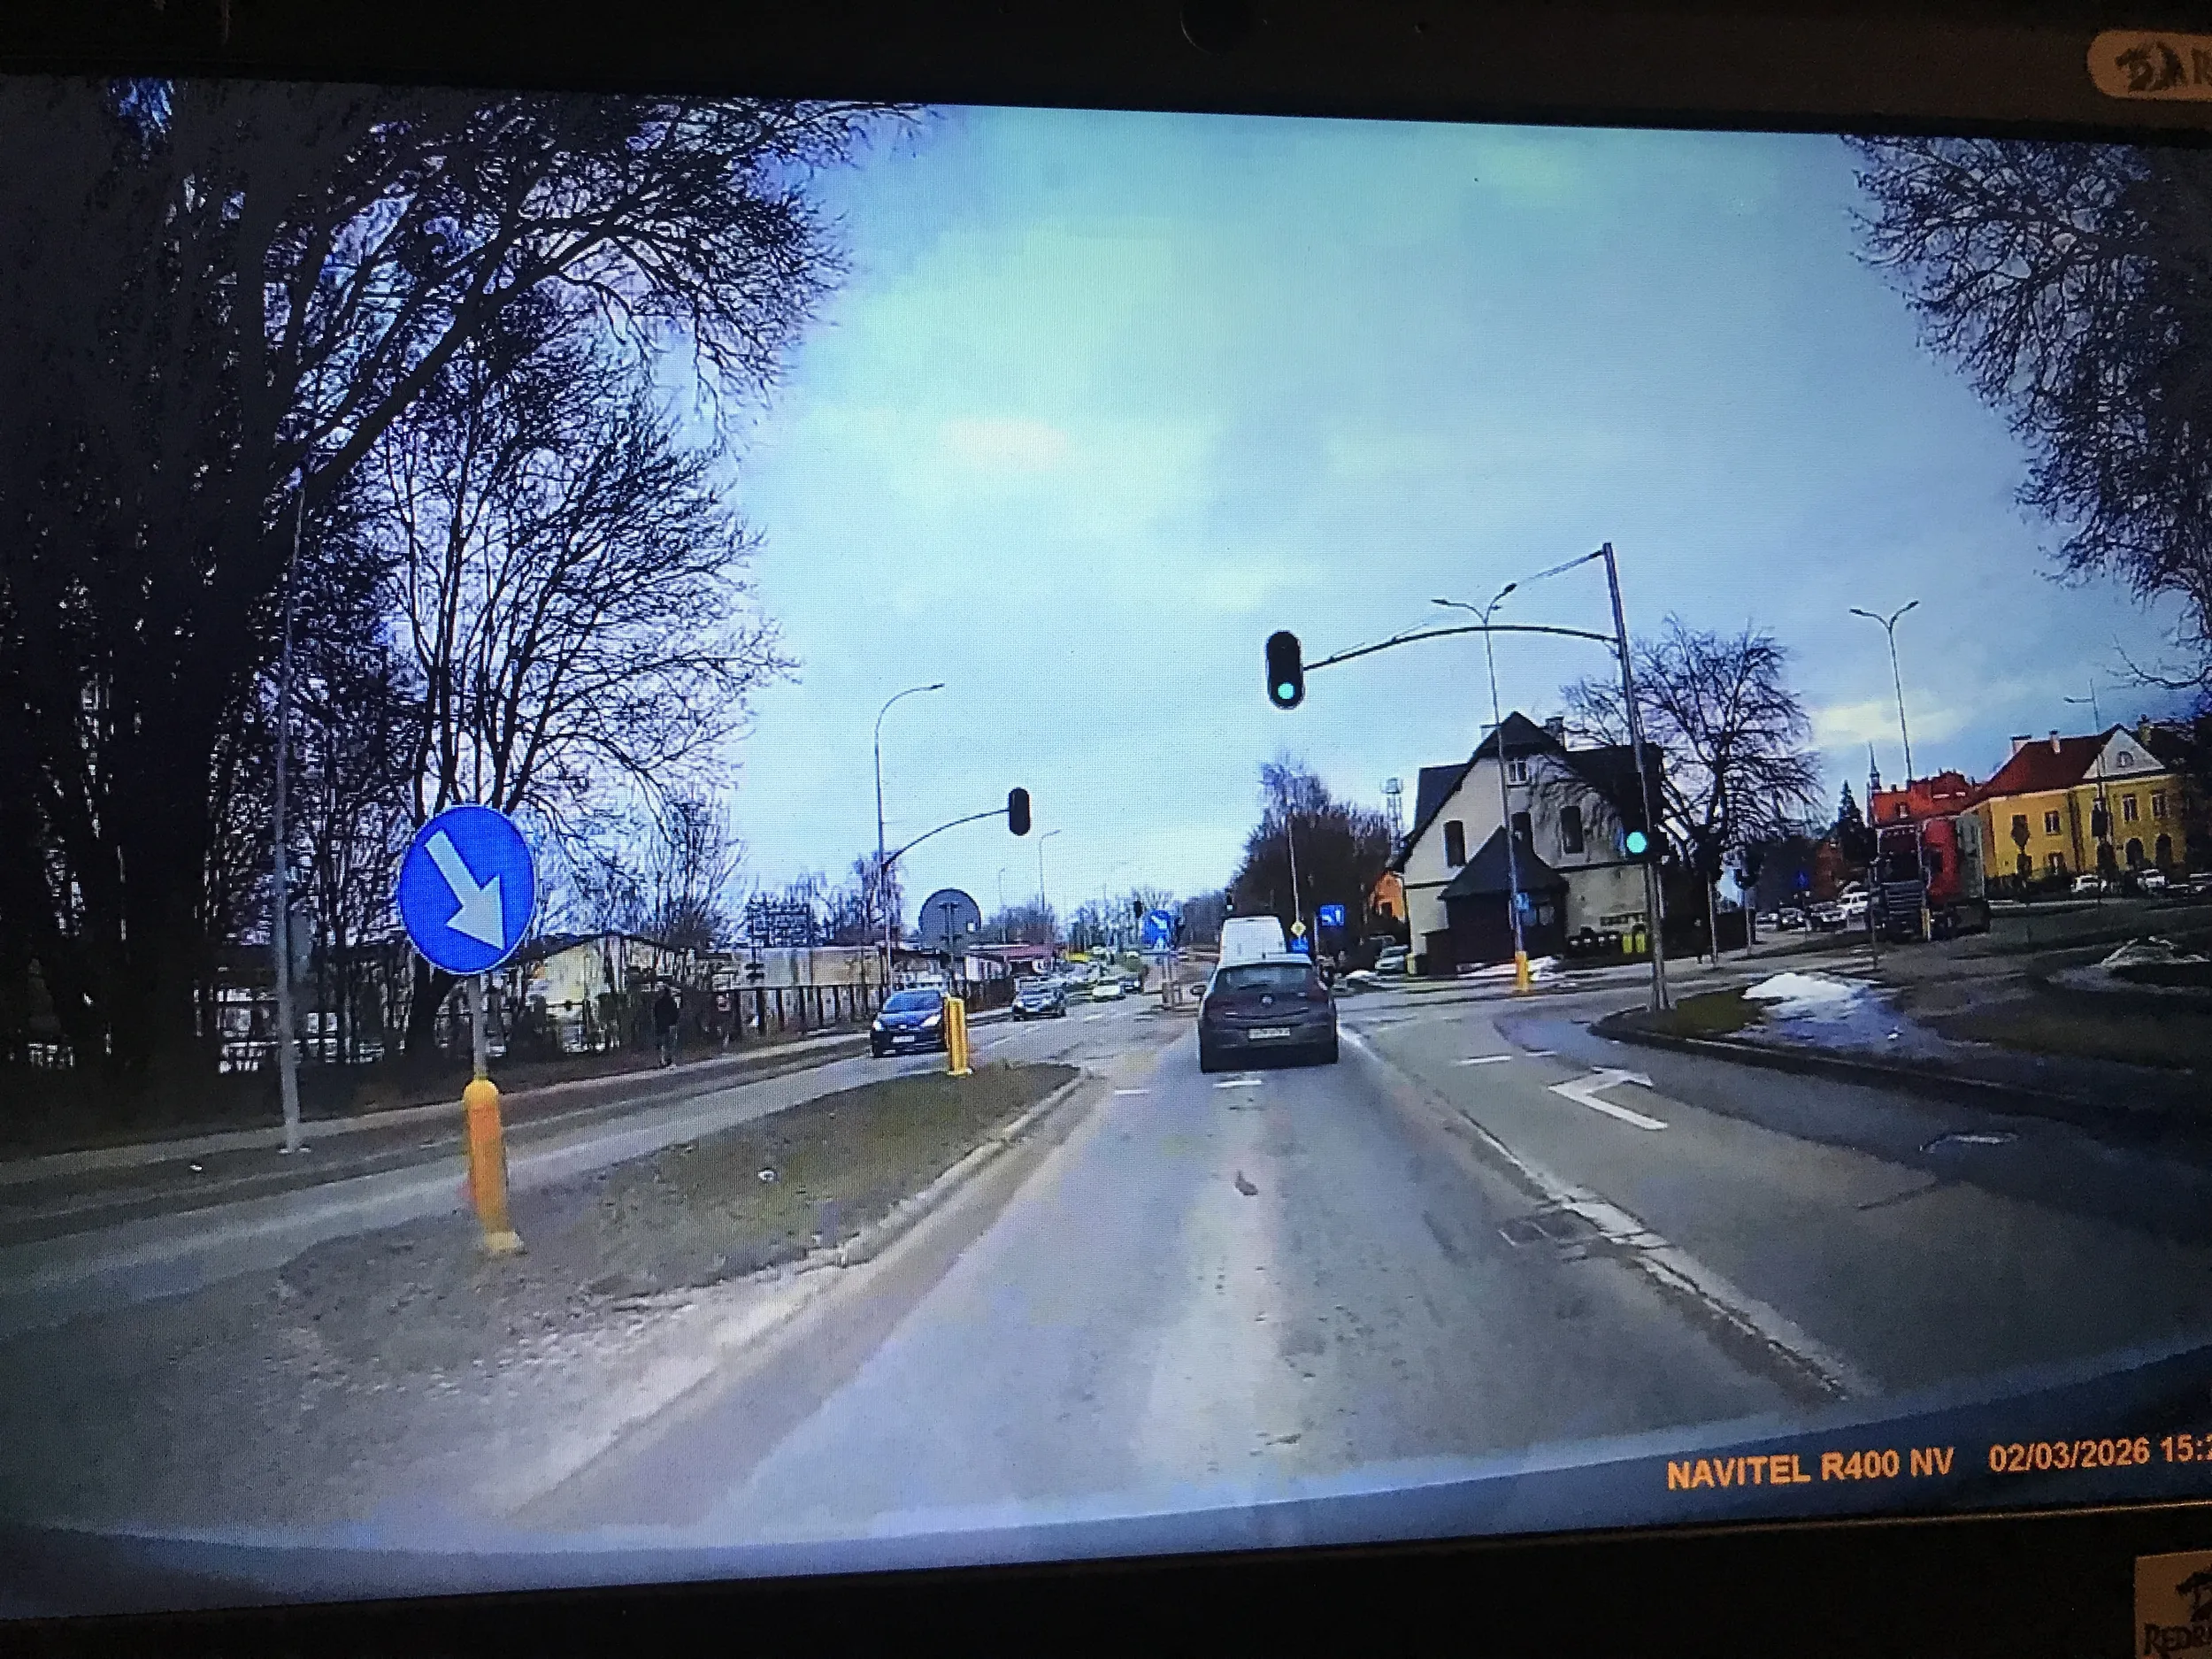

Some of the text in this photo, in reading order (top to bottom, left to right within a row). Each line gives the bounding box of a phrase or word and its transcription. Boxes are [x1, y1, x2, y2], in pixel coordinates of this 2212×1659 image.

[1667, 1454, 1810, 1490] NAVITEL
[1821, 1449, 1900, 1481] R400
[1910, 1446, 1955, 1477] NV
[1989, 1436, 2150, 1472] 02/03/2026
